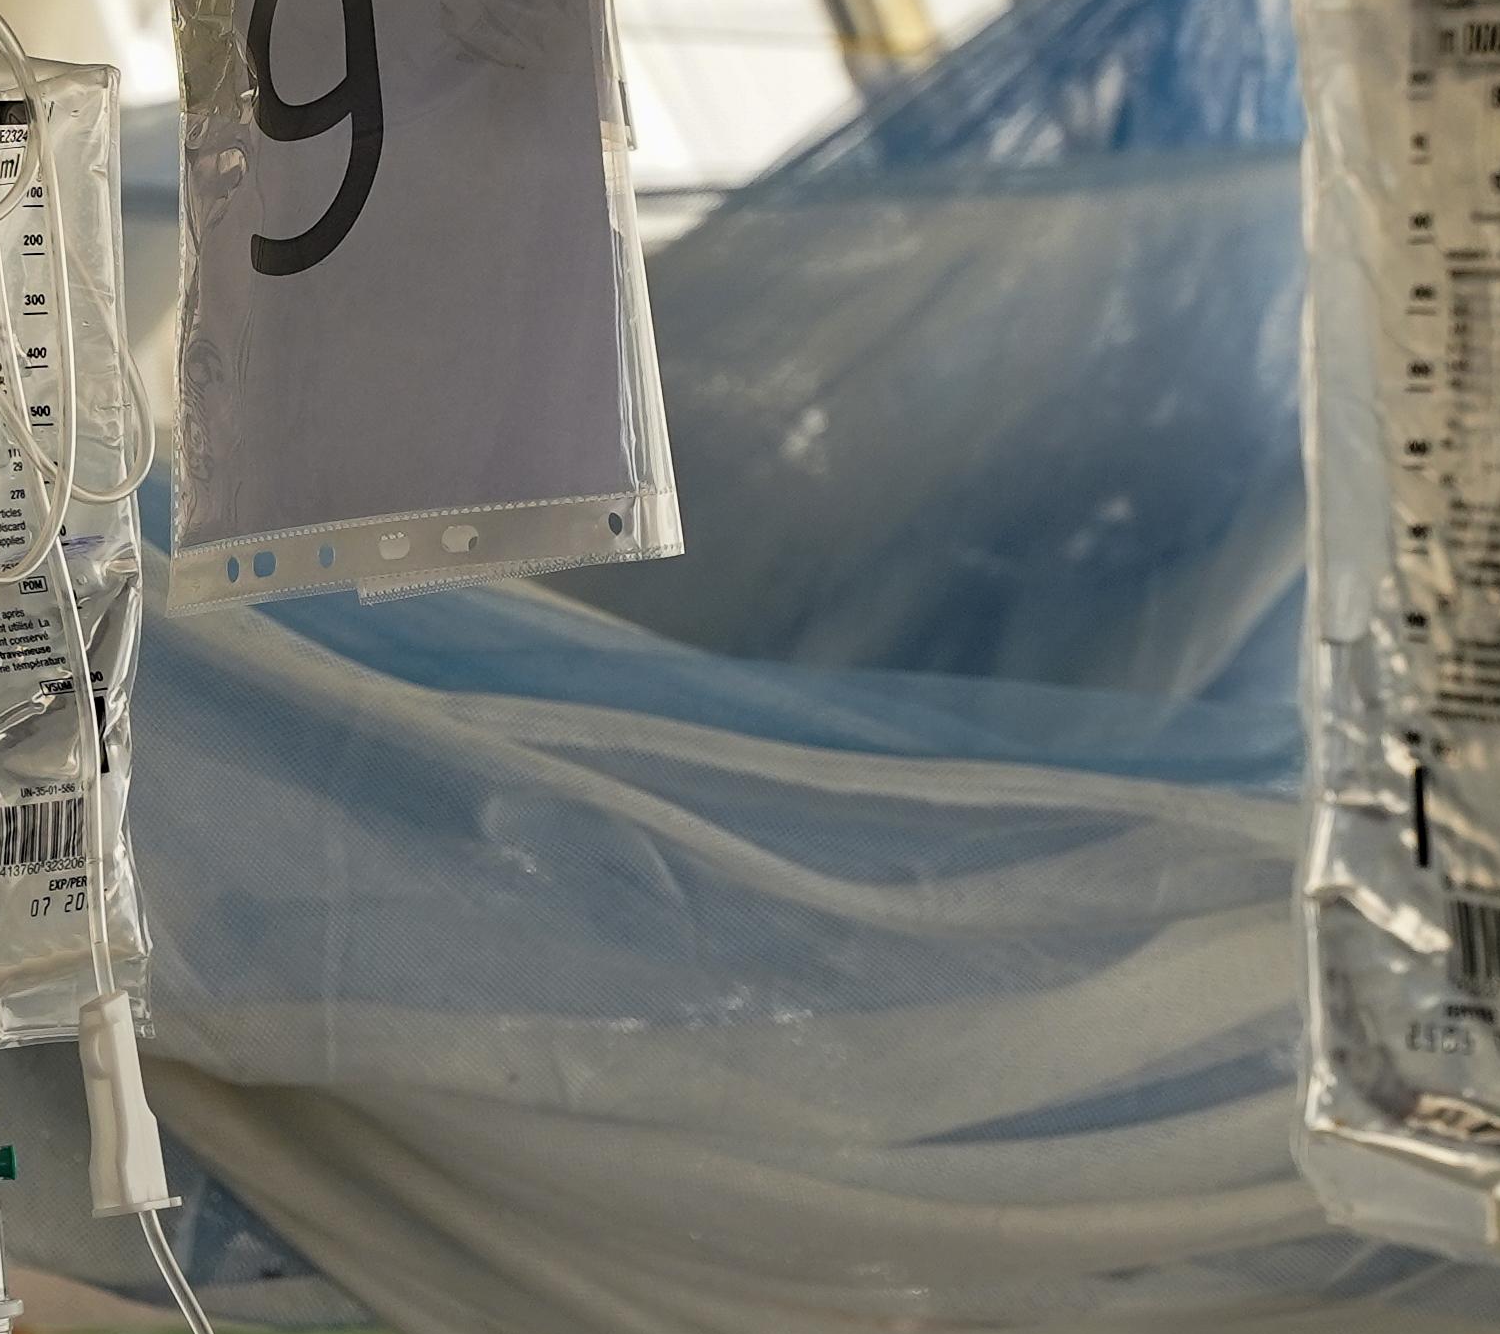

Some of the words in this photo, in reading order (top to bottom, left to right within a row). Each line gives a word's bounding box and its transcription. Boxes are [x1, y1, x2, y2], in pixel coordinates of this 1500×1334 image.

[0, 154, 20, 178] ml
[23, 234, 43, 246] 200
[24, 294, 46, 305] 300
[26, 347, 47, 359] 400
[30, 405, 51, 417] 500
[13, 462, 22, 472] 29
[10, 489, 26, 500] 278
[23, 580, 43, 591] POM
[1, 608, 25, 620] après
[8, 621, 34, 632] utilisé
[38, 618, 50, 628] La
[10, 631, 49, 645] conservé
[13, 656, 66, 672] température
[0, 862, 40, 877] 413760
[30, 896, 51, 917] 07
[64, 892, 86, 913] 20
